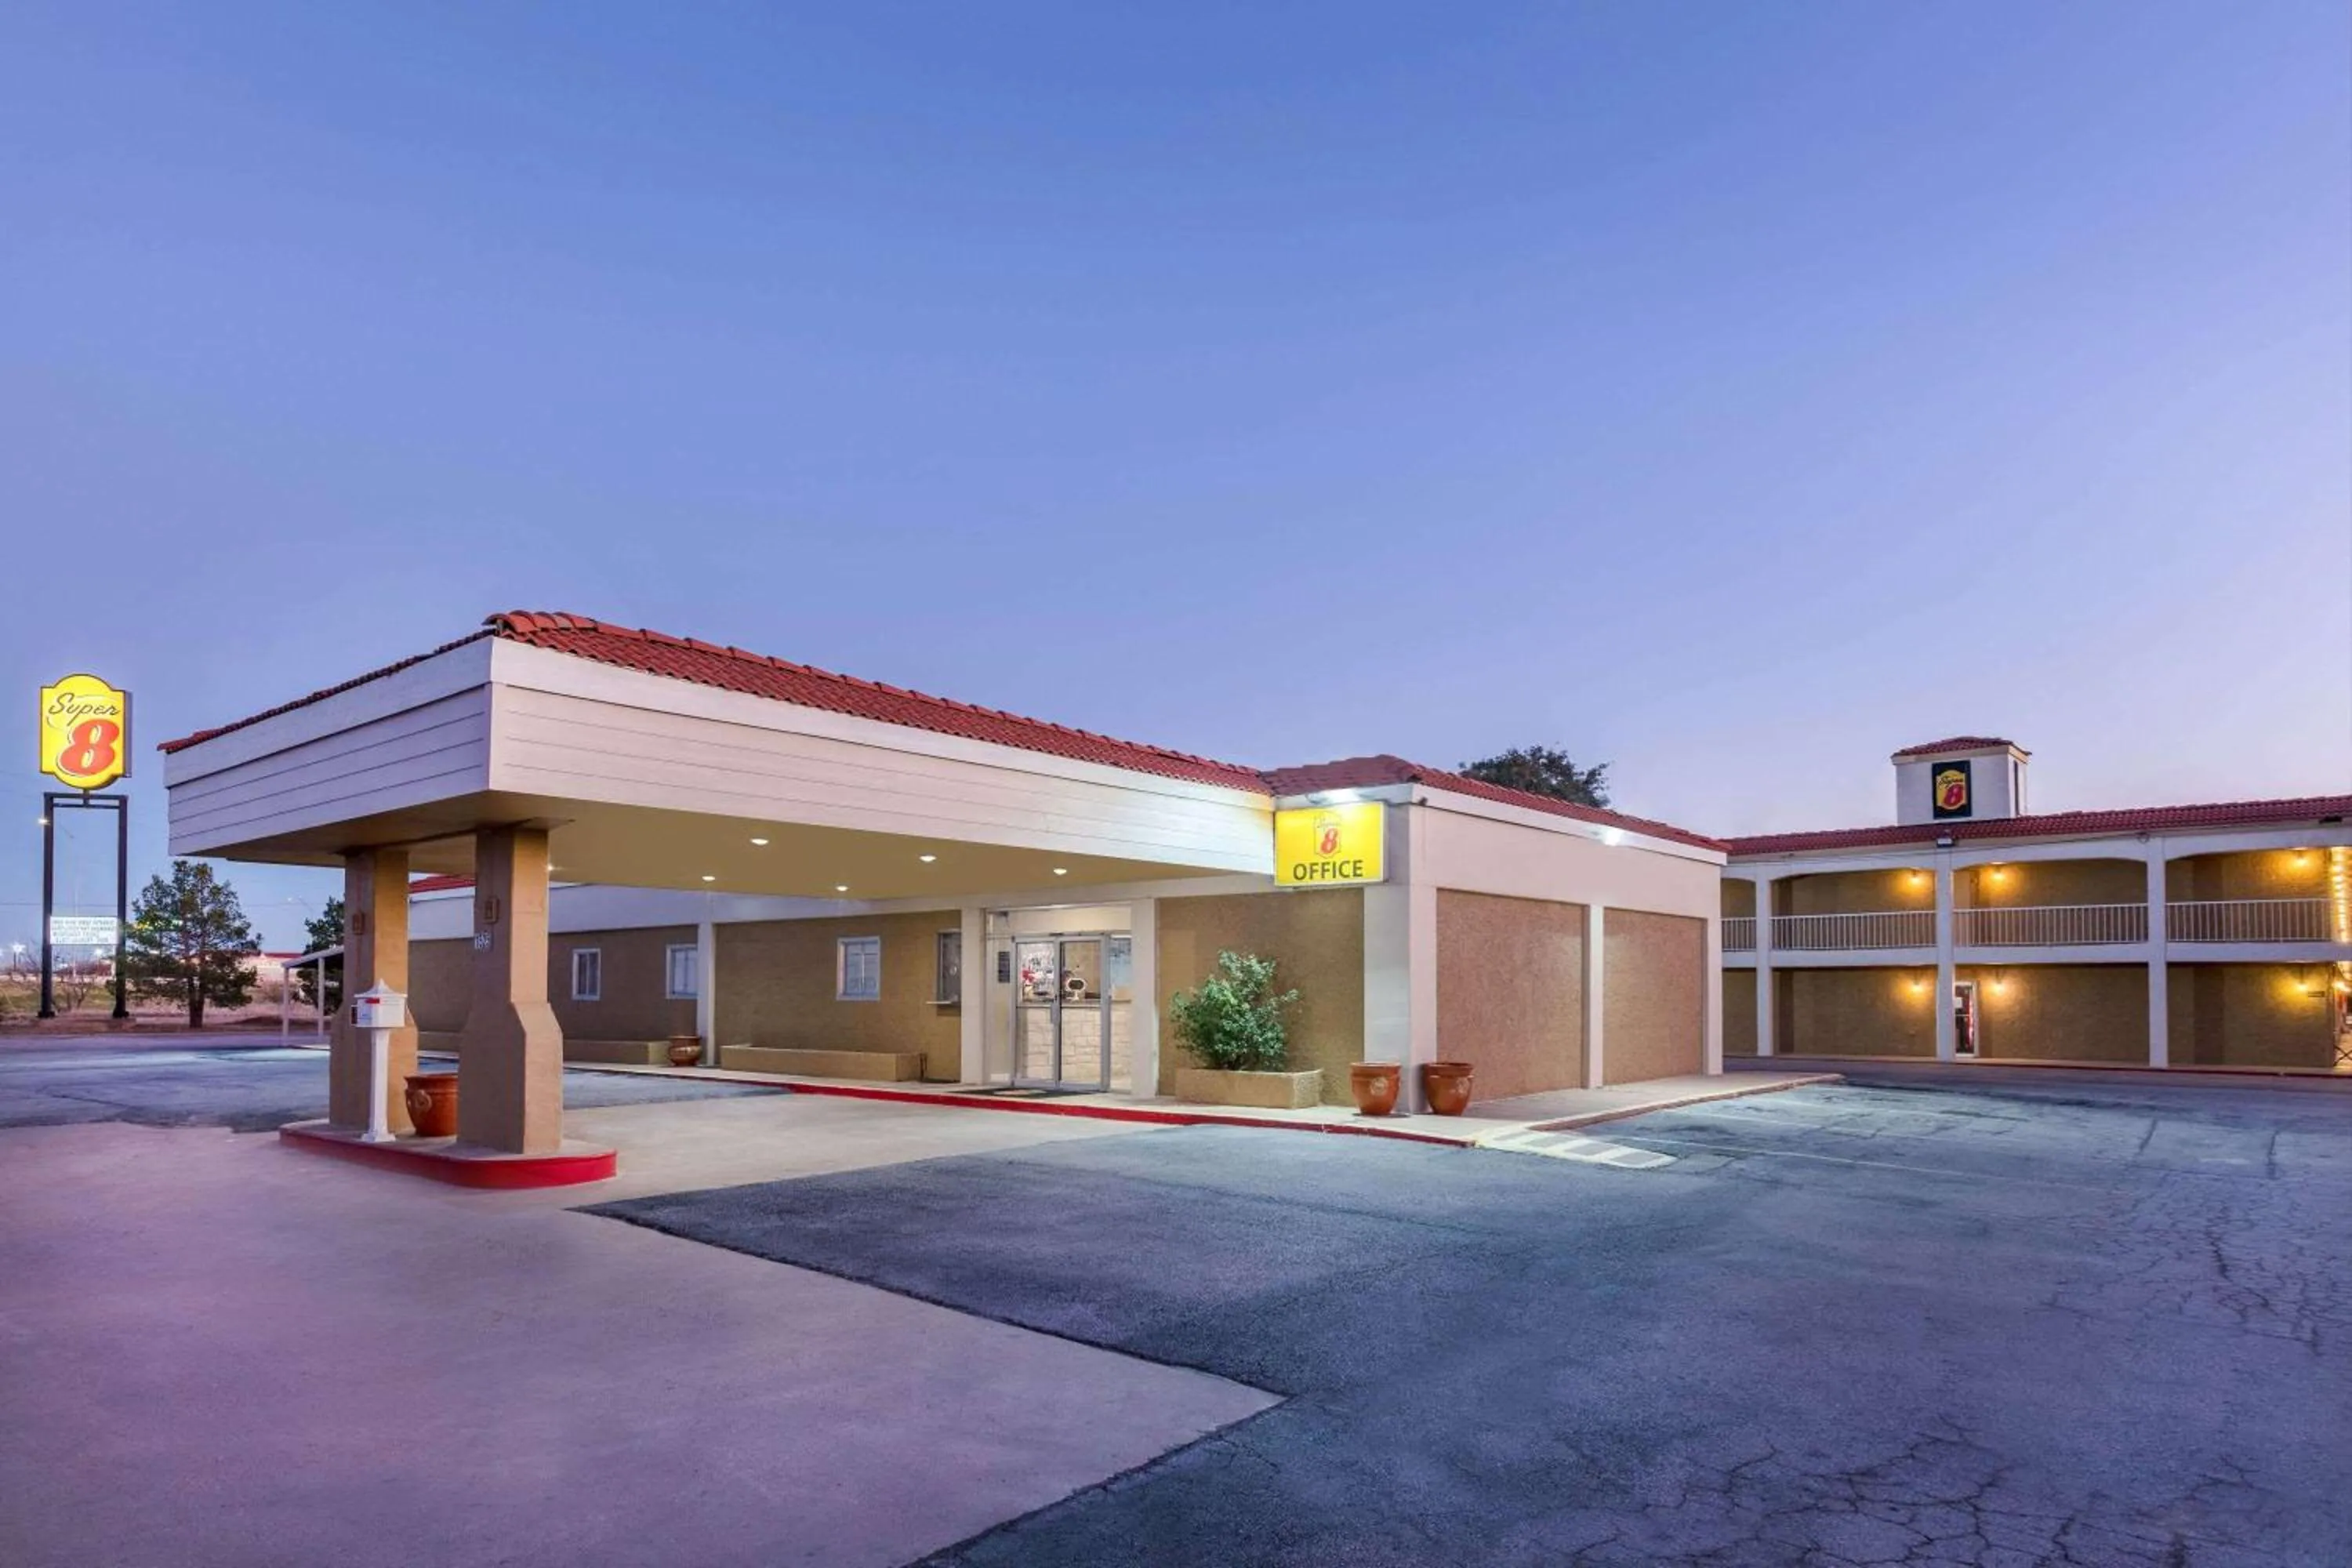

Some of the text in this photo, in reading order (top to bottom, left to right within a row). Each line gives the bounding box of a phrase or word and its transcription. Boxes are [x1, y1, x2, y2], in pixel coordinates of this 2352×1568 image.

[48, 692, 121, 726] Super
[58, 719, 119, 775] 8
[1944, 784, 1964, 807] 8
[1320, 828, 1338, 854] 8
[1293, 860, 1363, 880] OFFICE
